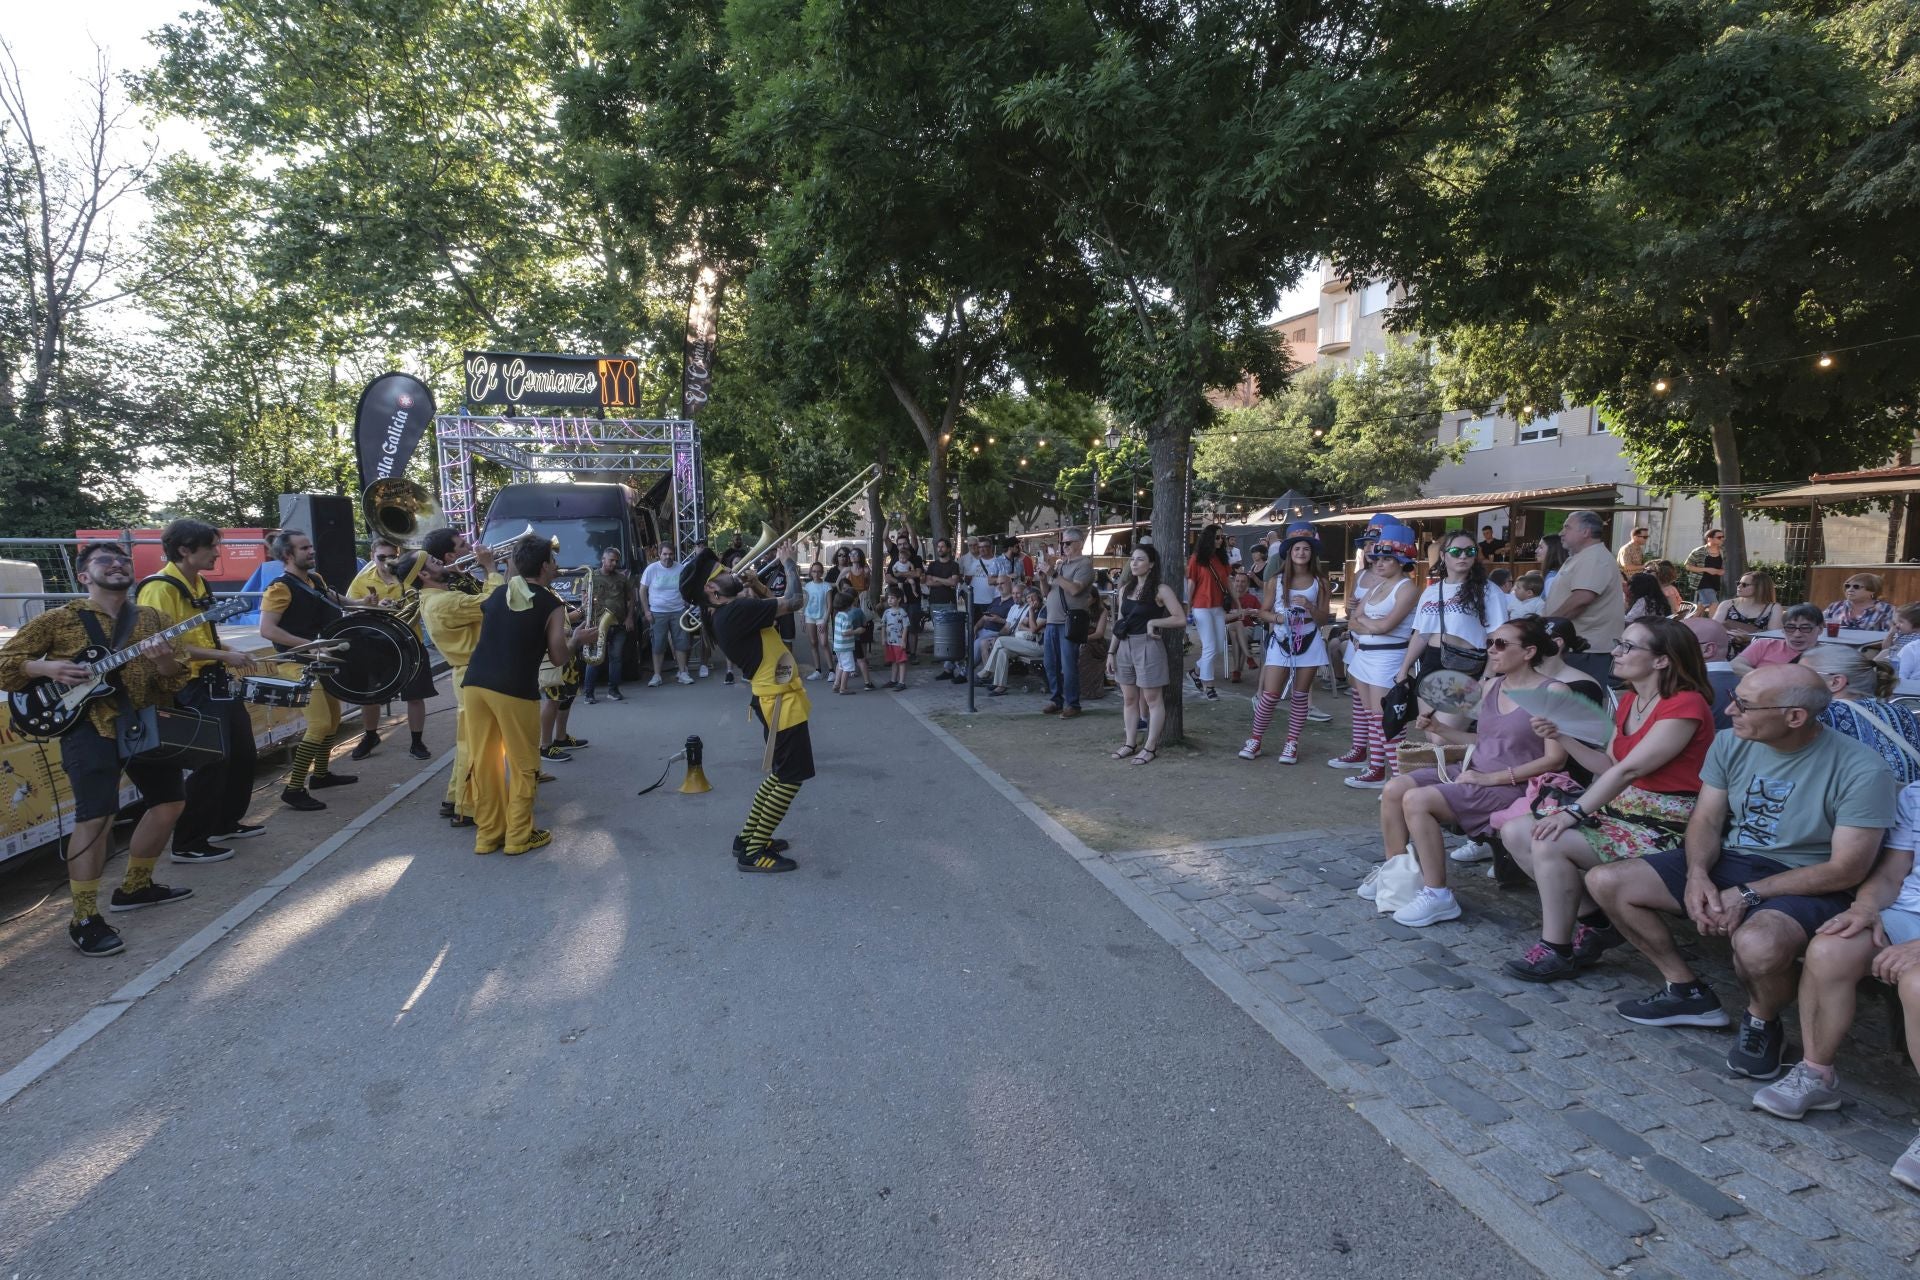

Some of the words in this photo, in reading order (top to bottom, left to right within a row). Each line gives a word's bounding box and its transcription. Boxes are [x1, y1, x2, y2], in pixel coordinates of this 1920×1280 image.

[467, 356, 498, 401] El
[502, 358, 598, 401] Comienzo
[381, 409, 409, 454] Galicia
